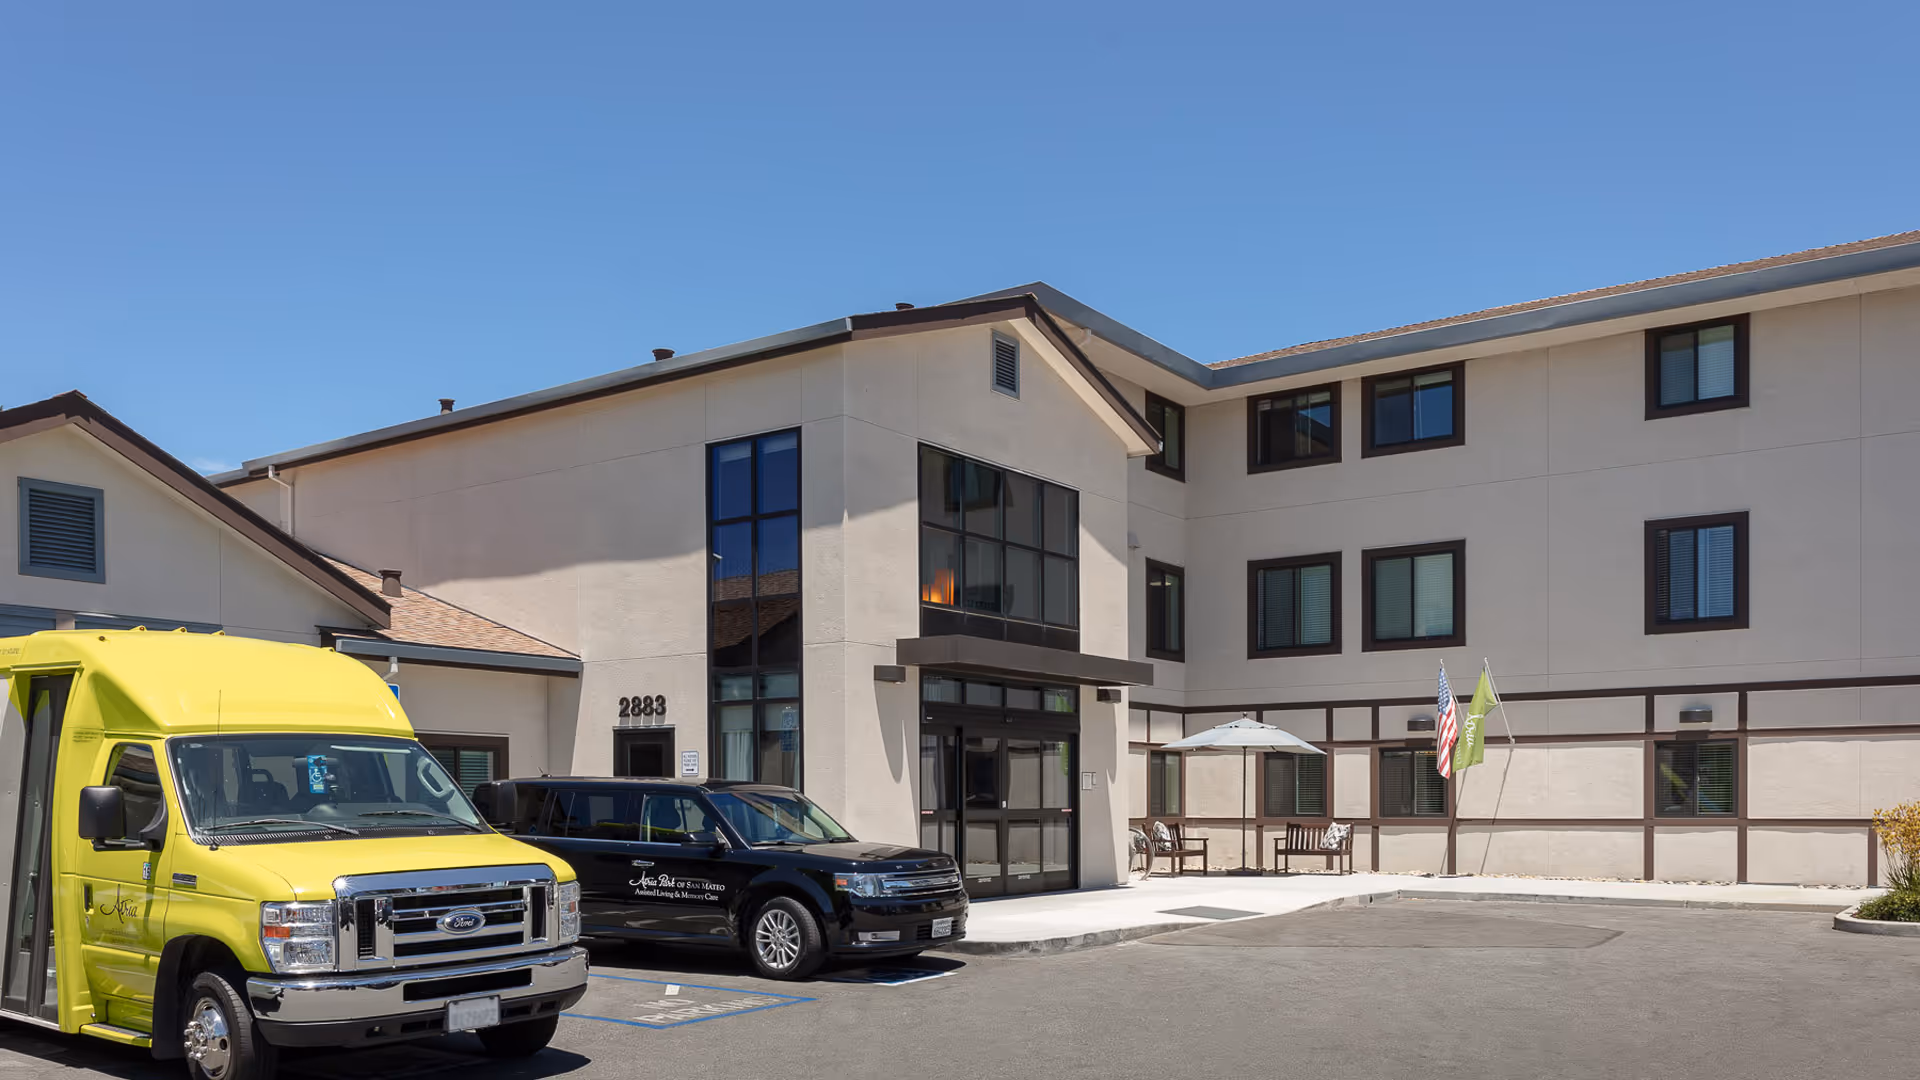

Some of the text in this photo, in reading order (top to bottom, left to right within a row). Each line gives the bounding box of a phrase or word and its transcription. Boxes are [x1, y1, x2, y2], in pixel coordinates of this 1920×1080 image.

[618, 694, 667, 717] 2883
[629, 871, 657, 889] Atria
[658, 873, 675, 888] Park
[635, 888, 719, 901] Assisted Living & Memory Care
[100, 884, 138, 924] Atria
[453, 916, 475, 928] Ford
